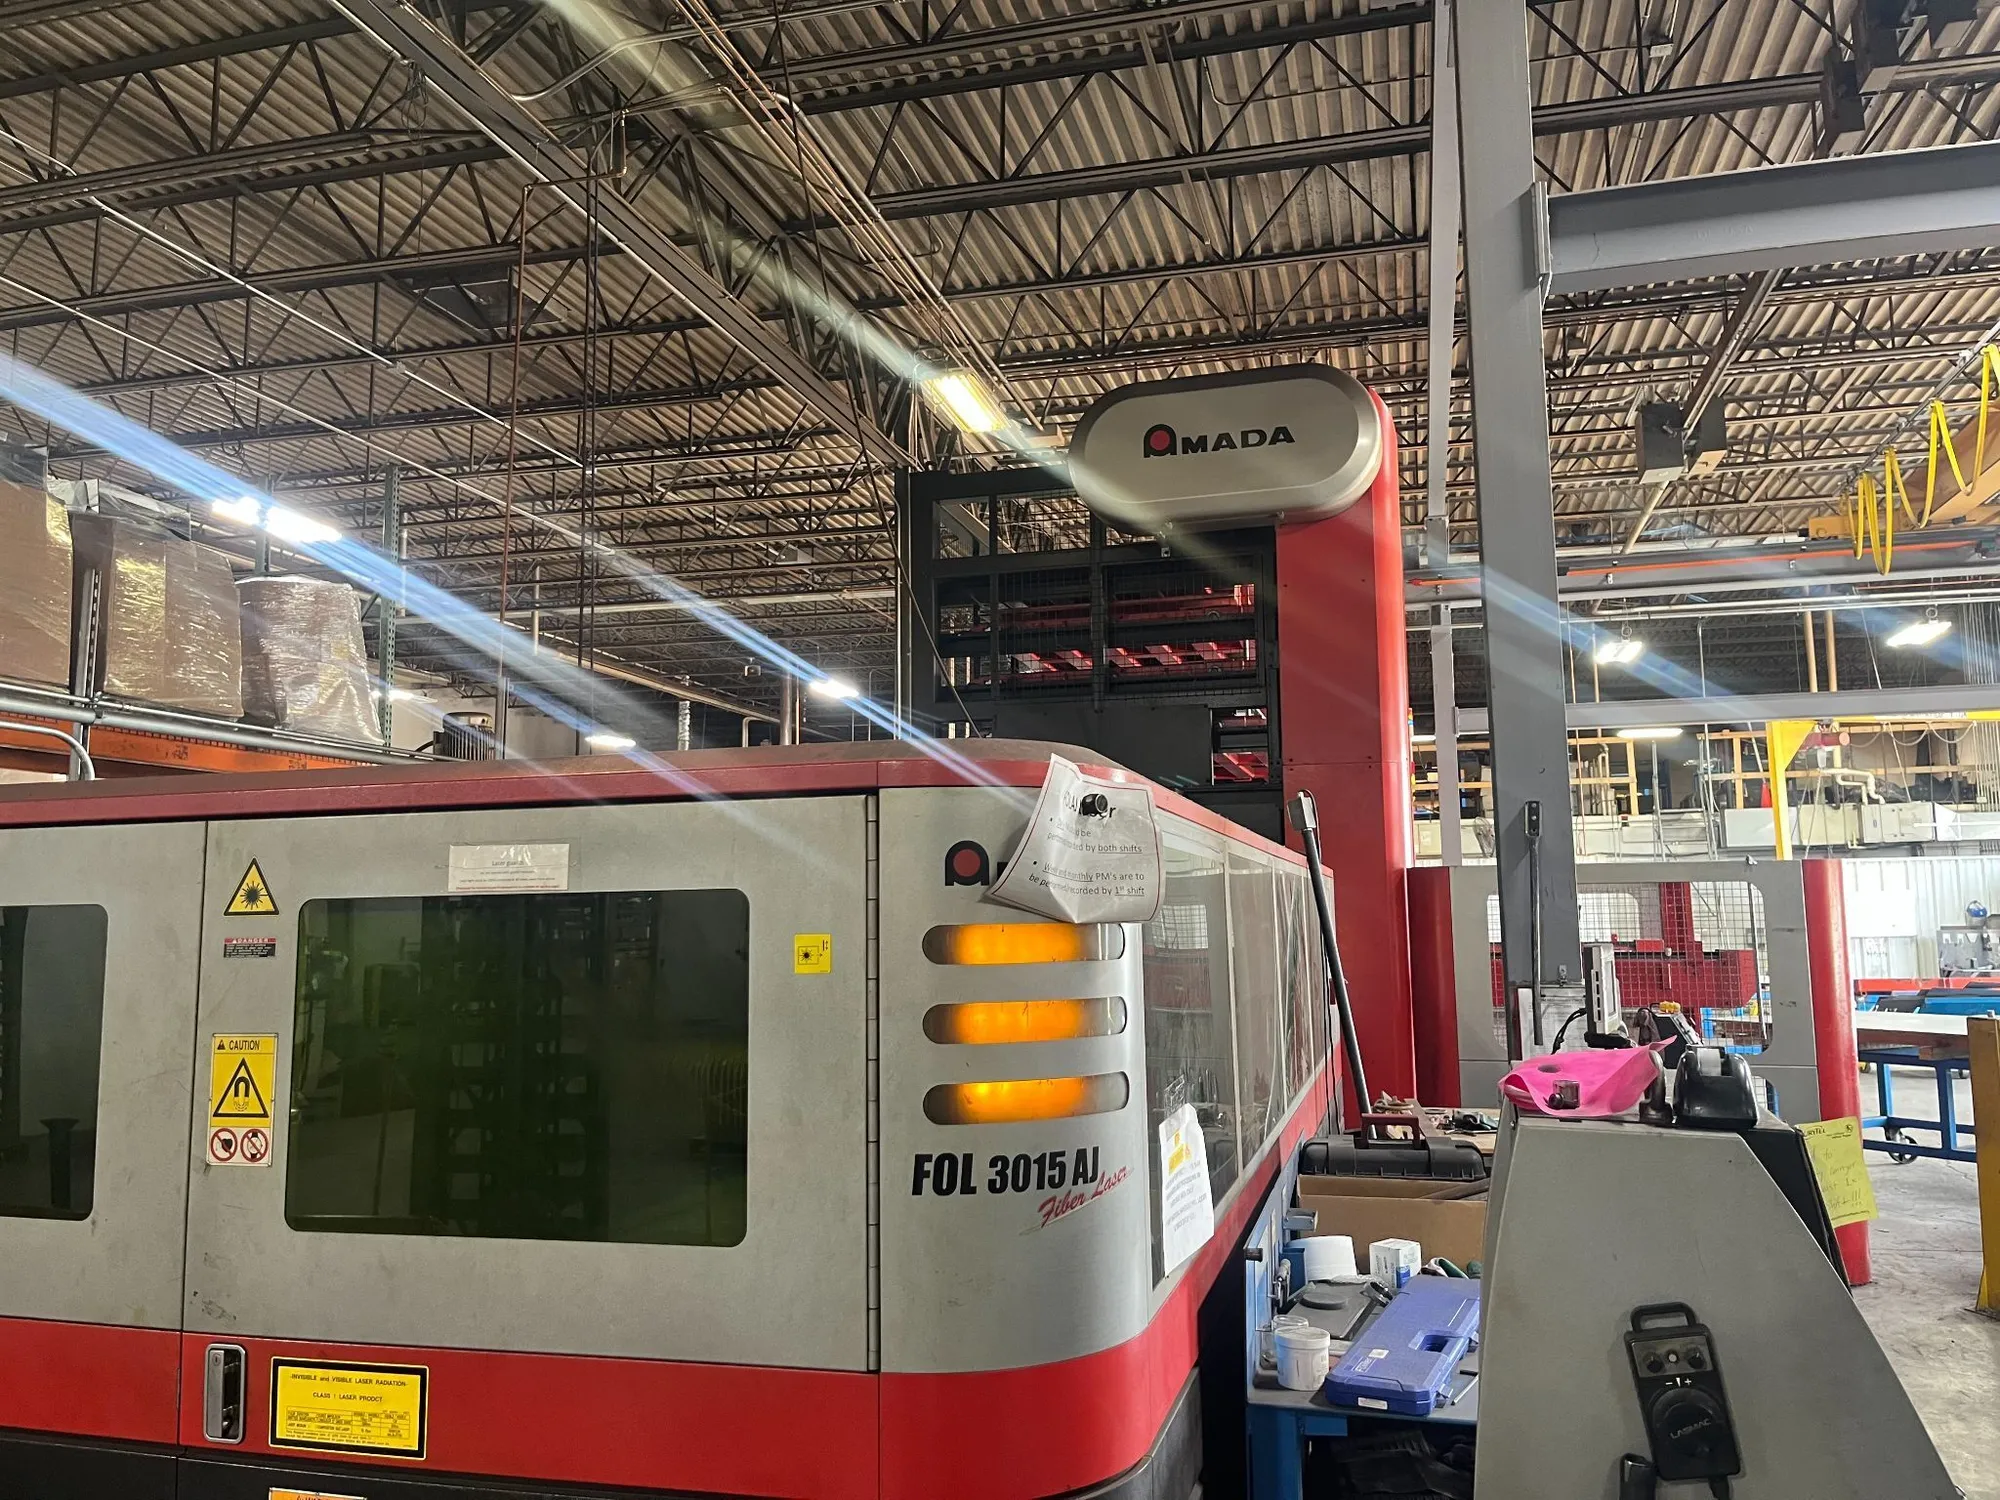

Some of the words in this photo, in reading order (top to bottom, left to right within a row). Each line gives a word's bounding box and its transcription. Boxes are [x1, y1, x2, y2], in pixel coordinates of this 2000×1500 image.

[1143, 423, 1296, 458] AMADA
[1085, 843, 1097, 853] by
[1098, 843, 1117, 852] both
[1119, 844, 1142, 852] shifts
[1028, 873, 1038, 884] be
[1095, 872, 1117, 880] PM's
[1119, 873, 1134, 881] are
[1135, 873, 1145, 881] to
[1101, 886, 1112, 896] by
[1127, 886, 1145, 895] shift
[228, 1040, 260, 1051] CAUTION
[911, 1153, 977, 1196] FOL
[987, 1150, 1067, 1195] 3015
[1071, 1146, 1100, 1187] AJ
[1037, 1189, 1086, 1229] Fiber
[1089, 1164, 1129, 1200] Laser
[332, 1376, 352, 1384] VISIBLE
[354, 1377, 374, 1385] LASER
